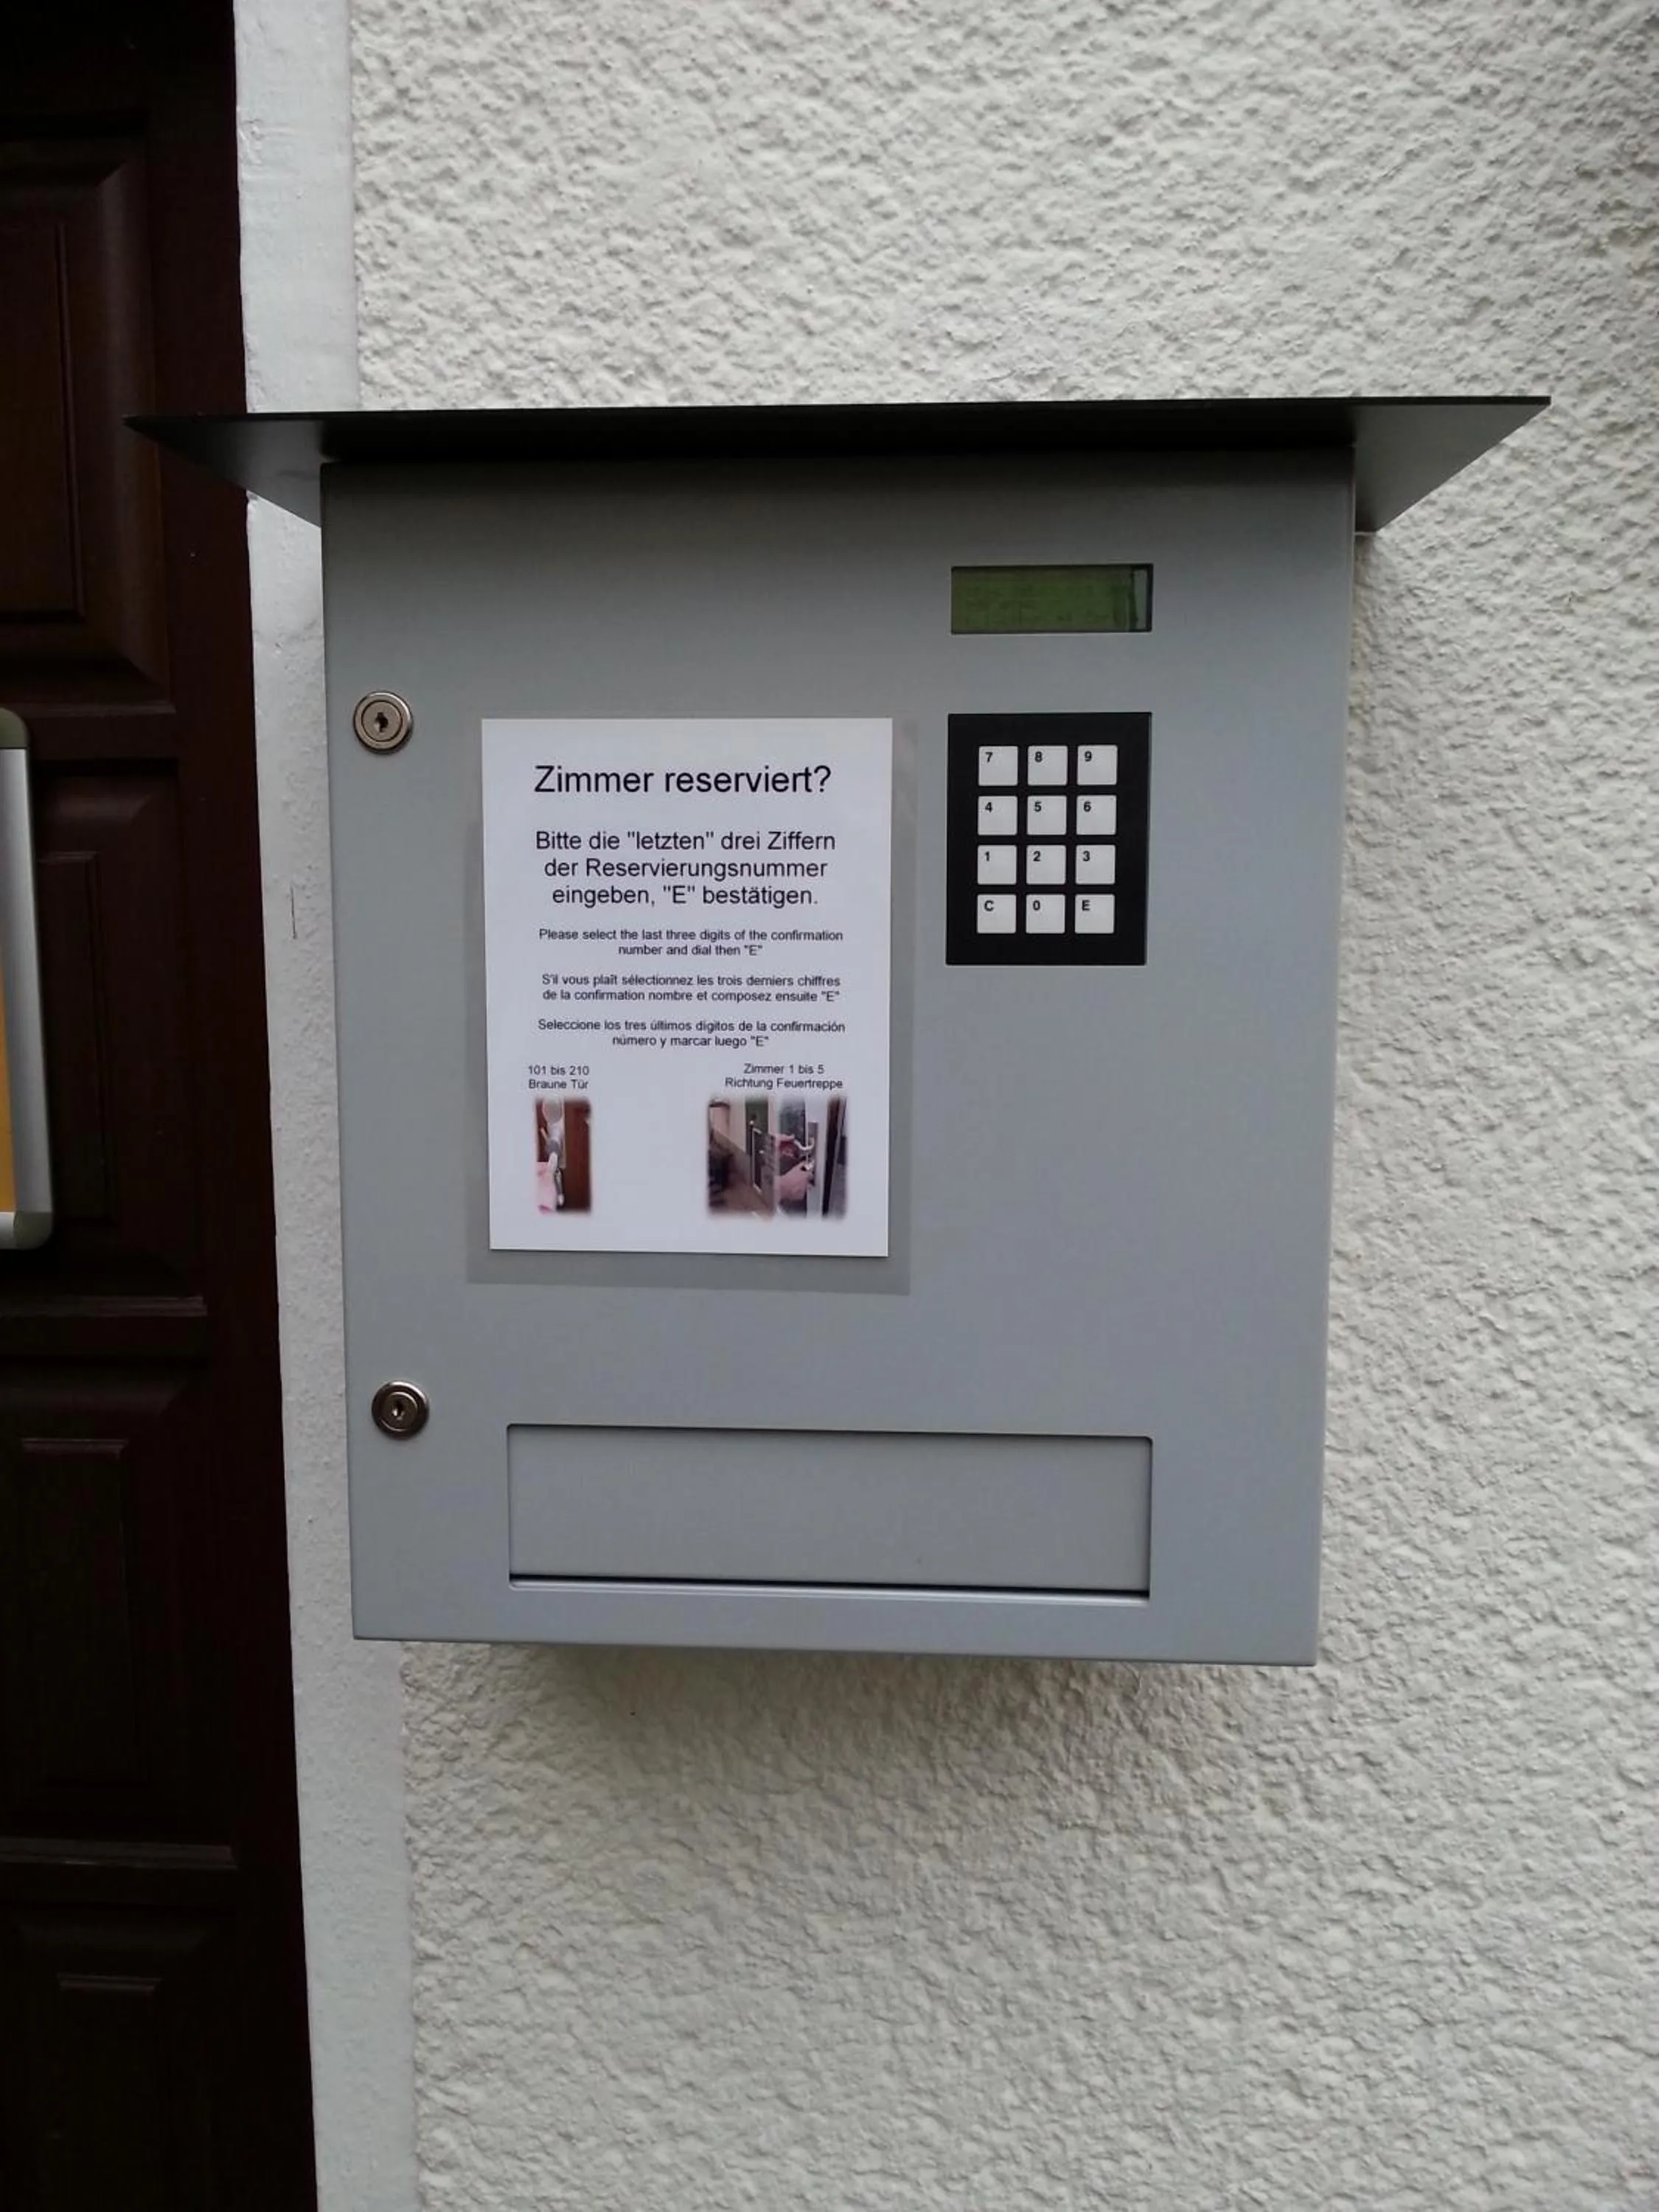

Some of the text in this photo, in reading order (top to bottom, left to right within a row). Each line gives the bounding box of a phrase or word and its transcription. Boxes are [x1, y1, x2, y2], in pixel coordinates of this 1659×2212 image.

[985, 752, 993, 762] 7
[1034, 751, 1043, 762] 8
[1085, 751, 1092, 762] 9
[535, 765, 831, 793] Zimmer reserviert?
[985, 802, 992, 813] 4
[1034, 801, 1041, 813] 5
[1084, 801, 1091, 812] 6
[537, 831, 835, 849] Bitte die "letzten" drei Ziffern
[985, 852, 990, 861] 1
[1033, 851, 1040, 861] 2
[1083, 851, 1090, 861] 3
[545, 858, 827, 882] der Reservierungsnummer
[553, 885, 817, 908] eingeben, "E" bestätigen.
[984, 900, 994, 911] C
[1033, 900, 1040, 911] 0
[1082, 900, 1090, 911] E
[539, 928, 843, 942] Please select the last three digits of the confirmation
[619, 945, 762, 956] number and dial then "E"
[543, 973, 558, 985] S'il
[562, 976, 590, 985] vous
[622, 974, 693, 986] sélectionnez
[697, 975, 714, 986] les
[717, 975, 743, 986] trois
[746, 975, 793, 986] derniers
[798, 975, 841, 987] chiffres
[543, 990, 840, 1003] de la confirmation nombre et composez ensuite "E"
[538, 1018, 601, 1030] Seleccione
[605, 1020, 621, 1030] los
[625, 1020, 647, 1030] tres
[739, 1020, 753, 1032] de
[757, 1021, 767, 1032] la
[771, 1021, 845, 1032] confirmación
[660, 1038, 667, 1048] y
[670, 1037, 712, 1046] marcar
[715, 1036, 747, 1048] luego
[751, 1035, 768, 1047] "E"
[529, 1065, 590, 1076] 101 bis 210
[743, 1063, 824, 1074] Zimmer 1 bis 5
[529, 1079, 588, 1089] Braune Tür
[726, 1077, 843, 1091] Richtung Feuertreppe
